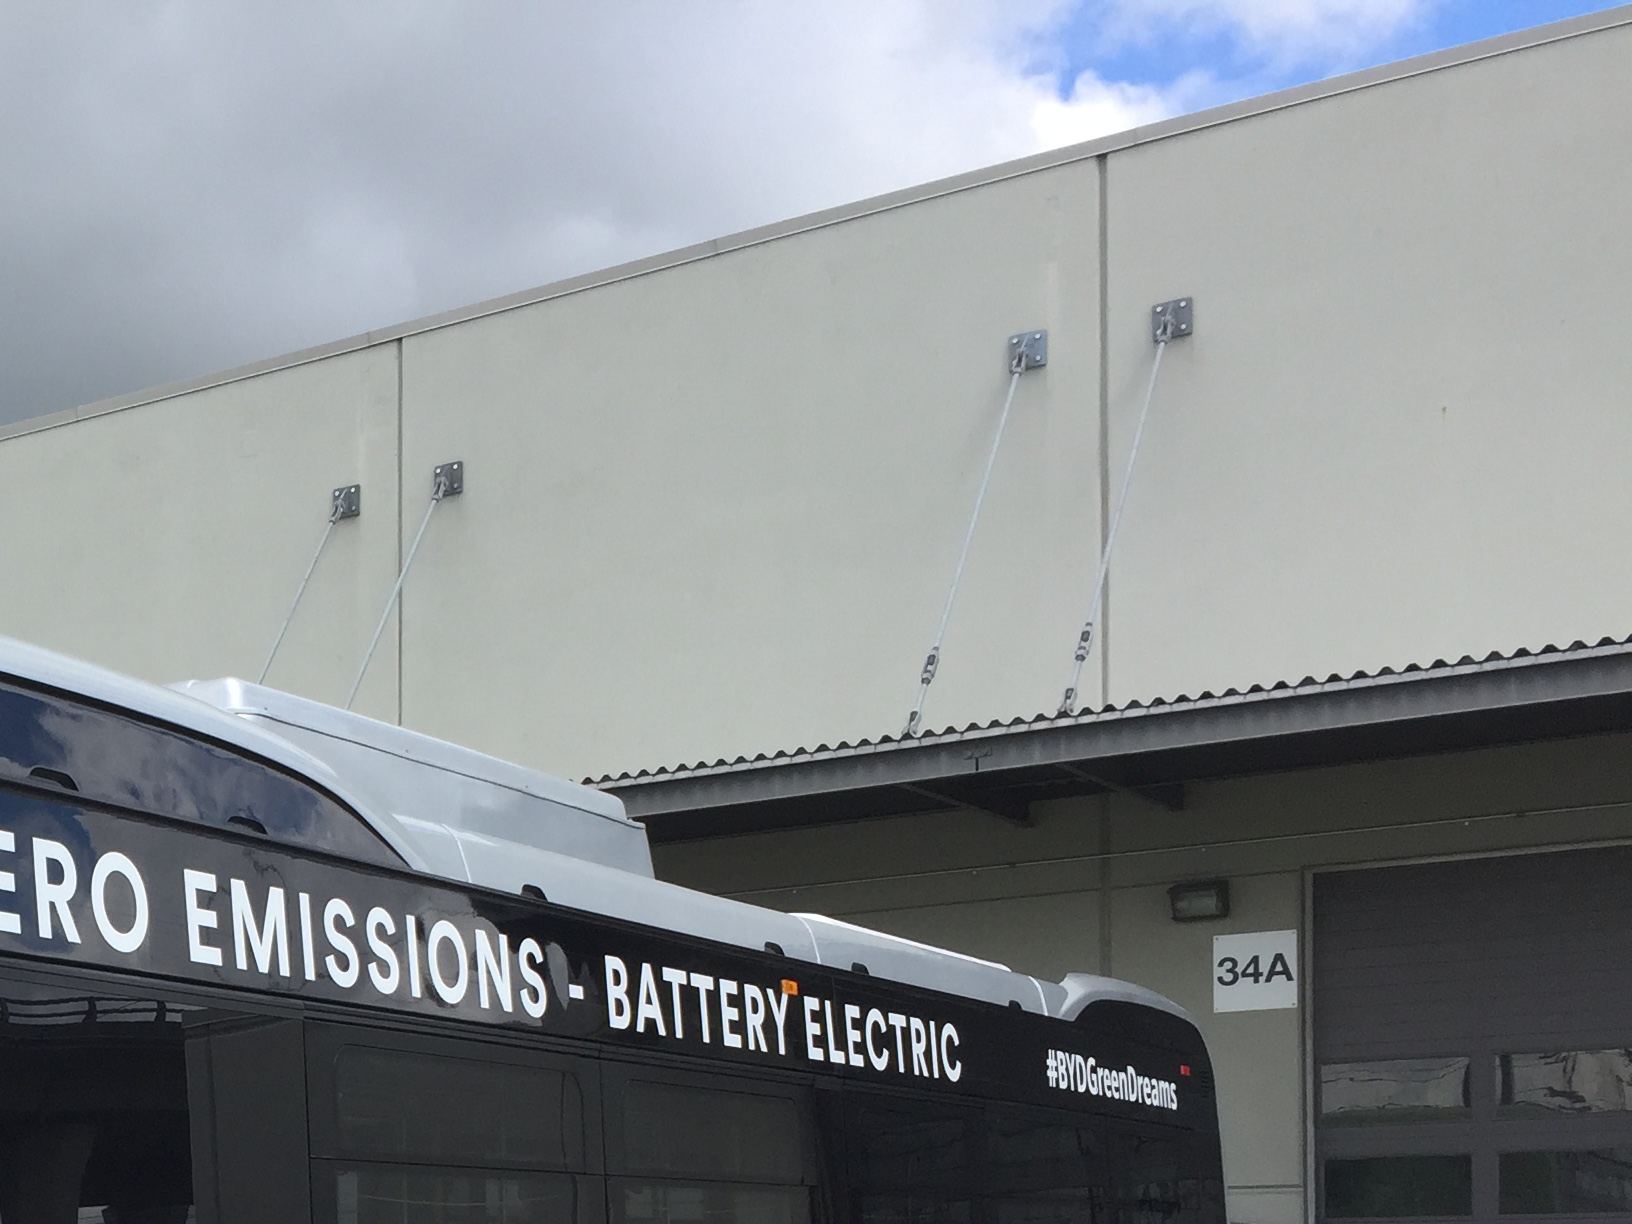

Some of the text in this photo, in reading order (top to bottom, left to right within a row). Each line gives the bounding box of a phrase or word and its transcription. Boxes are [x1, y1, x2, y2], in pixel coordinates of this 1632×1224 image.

[183, 868, 547, 1019] EMISSIONS
[604, 954, 789, 1056] BATTERY
[803, 995, 962, 1082] ELECTRIC
[1217, 952, 1294, 987] 34A
[1046, 1048, 1178, 1110] #BYDGreenDreams
